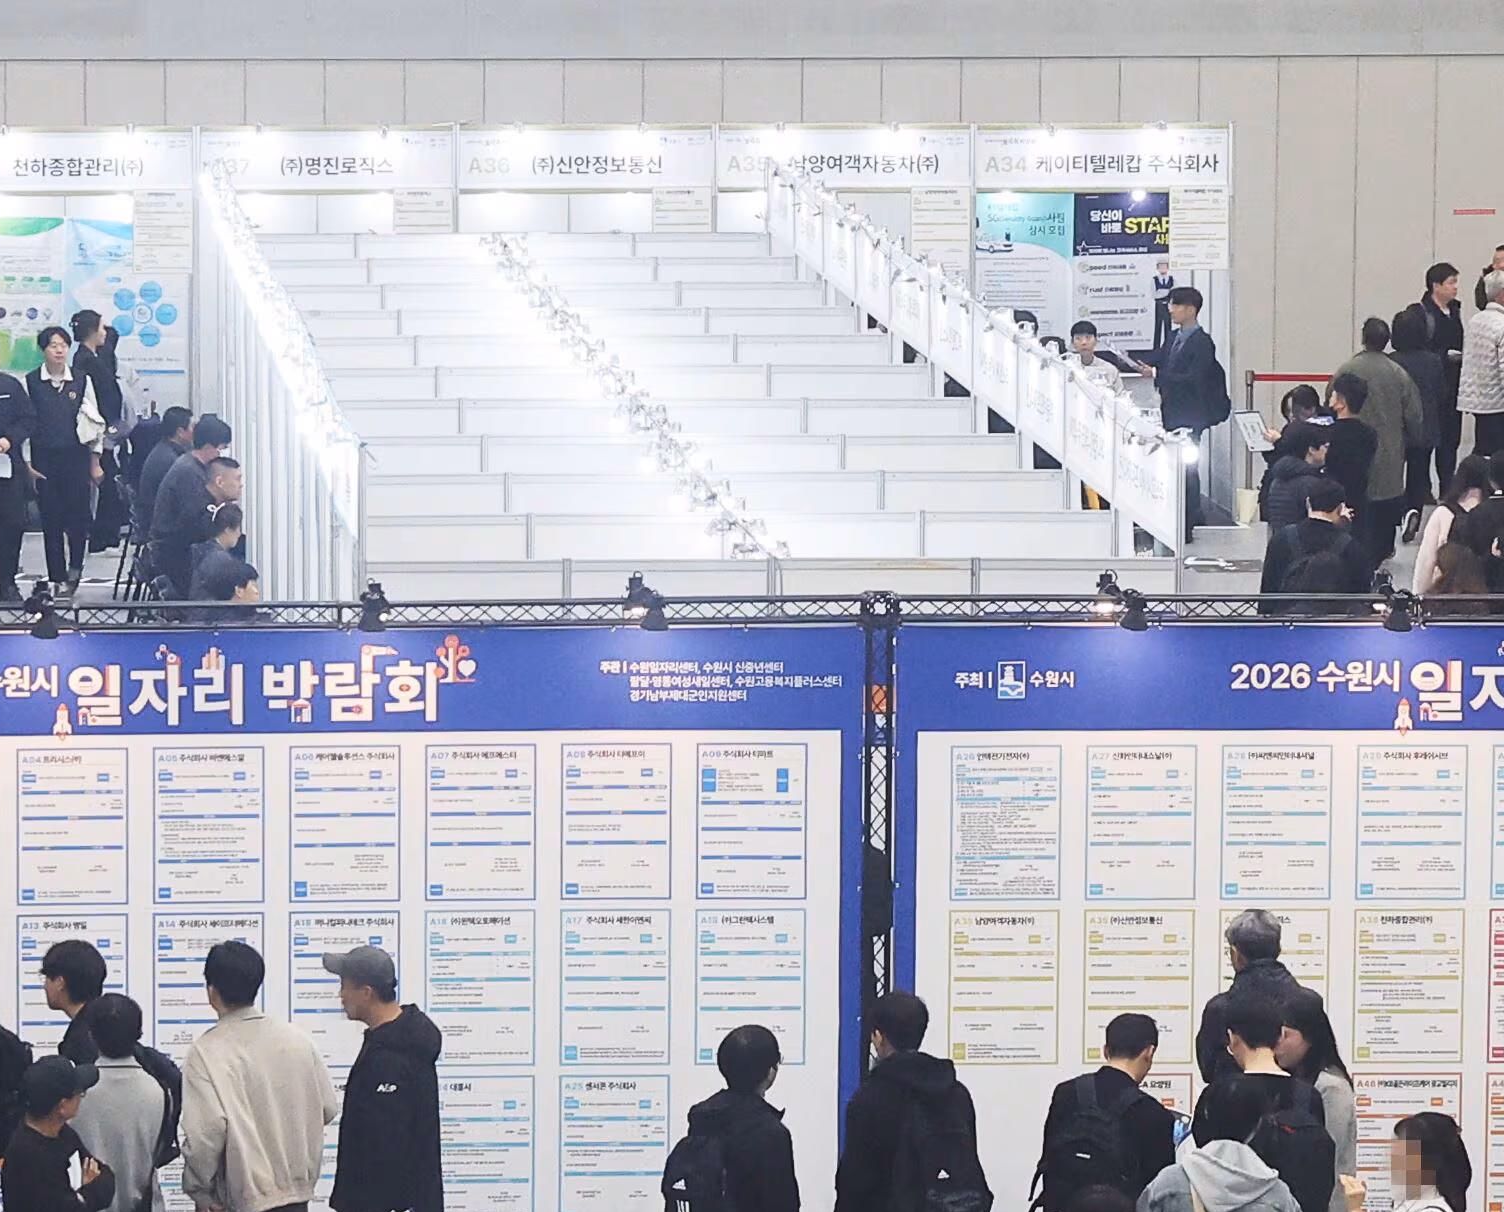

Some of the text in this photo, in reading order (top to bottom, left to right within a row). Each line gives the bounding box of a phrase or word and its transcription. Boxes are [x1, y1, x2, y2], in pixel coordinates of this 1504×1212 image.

[12, 157, 145, 180] 천하종합관리(주)
[280, 155, 394, 177] (주)명진로직스
[468, 154, 663, 177] A36 (주)신안정보통신
[984, 153, 1219, 174] A34 케이티텔레캅 주식회사
[1090, 209, 1123, 222] 당신이
[1101, 223, 1122, 234] 바로
[703, 660, 733, 673] 수원시
[1229, 663, 1312, 690] 2026
[1316, 660, 1401, 693] 수원시
[954, 668, 1075, 689] 주최 수원시
[67, 658, 245, 726] 일자리
[261, 658, 438, 723] 박람회
